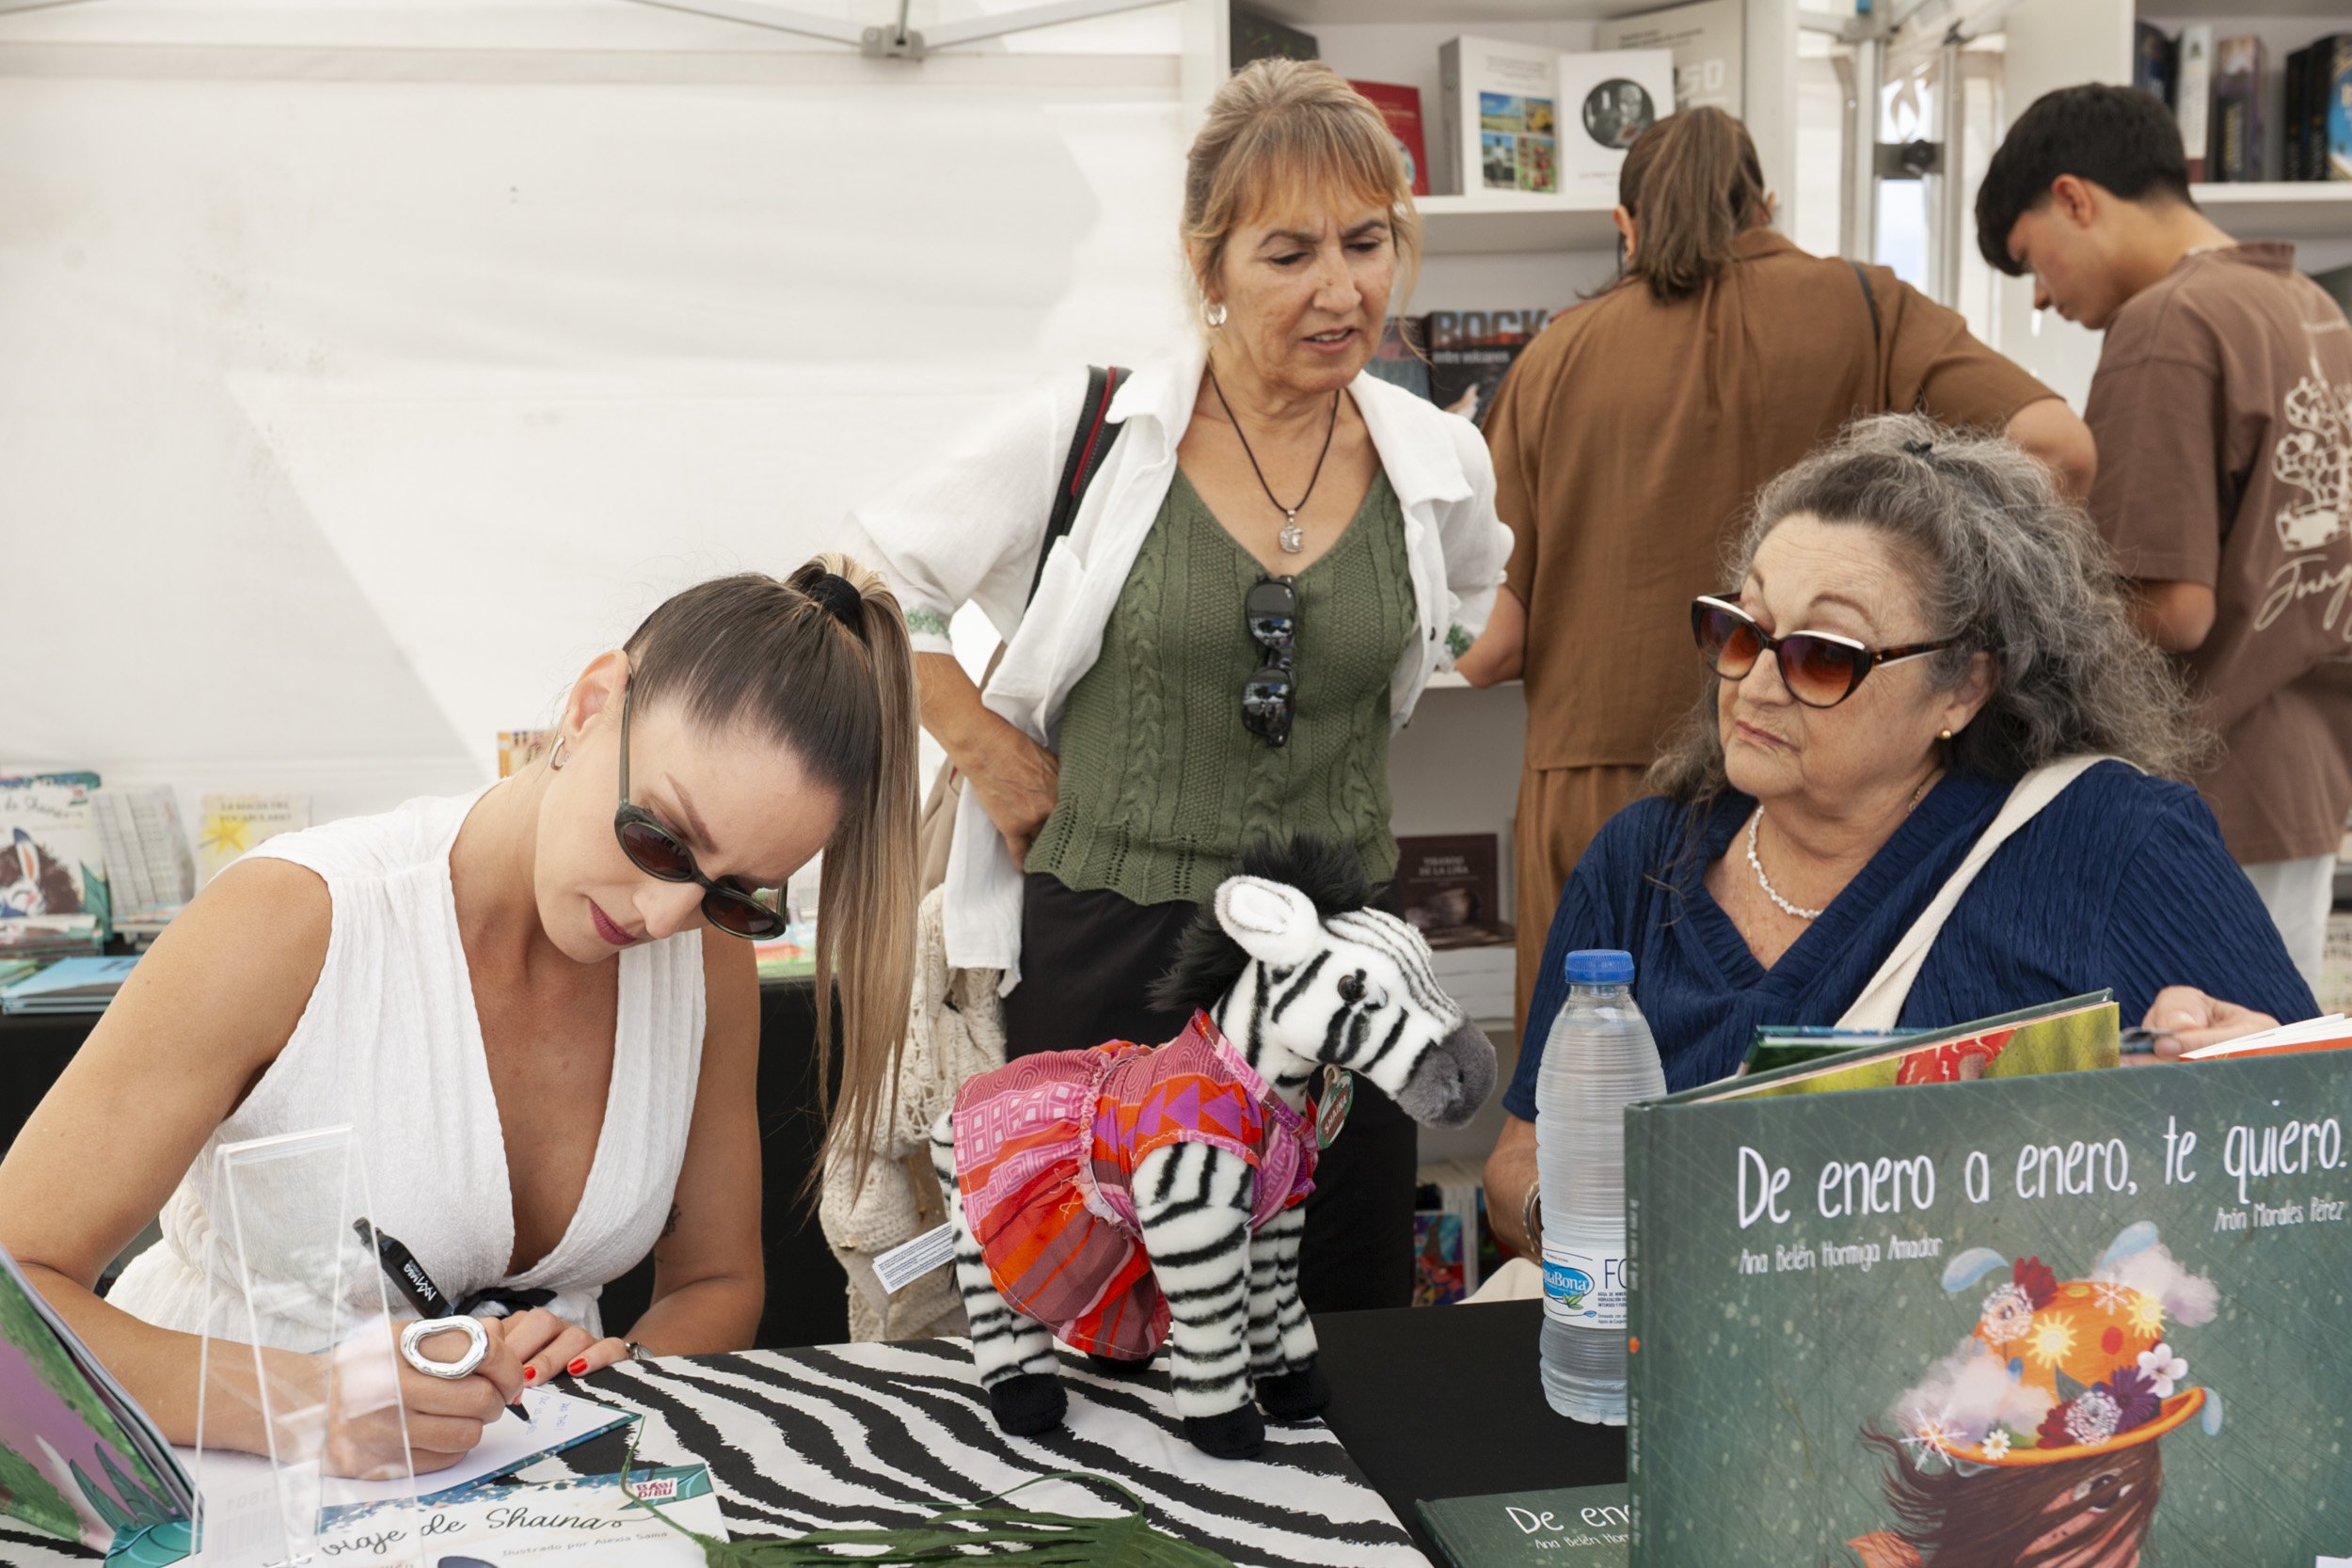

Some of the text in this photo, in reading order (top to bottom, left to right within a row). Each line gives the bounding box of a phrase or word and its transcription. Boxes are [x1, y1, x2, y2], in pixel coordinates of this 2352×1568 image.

[1325, 1095, 1347, 1134] SHAINA
[1739, 1115, 2347, 1229] De enero a enero, te quiero.
[1739, 1233, 1944, 1275] Ana Belén Hormiga Amador
[485, 1507, 623, 1530] Shaina
[1505, 1507, 1564, 1534] De
[1534, 1538, 1561, 1550] Ana
[1602, 1532, 1629, 1544] Hor
